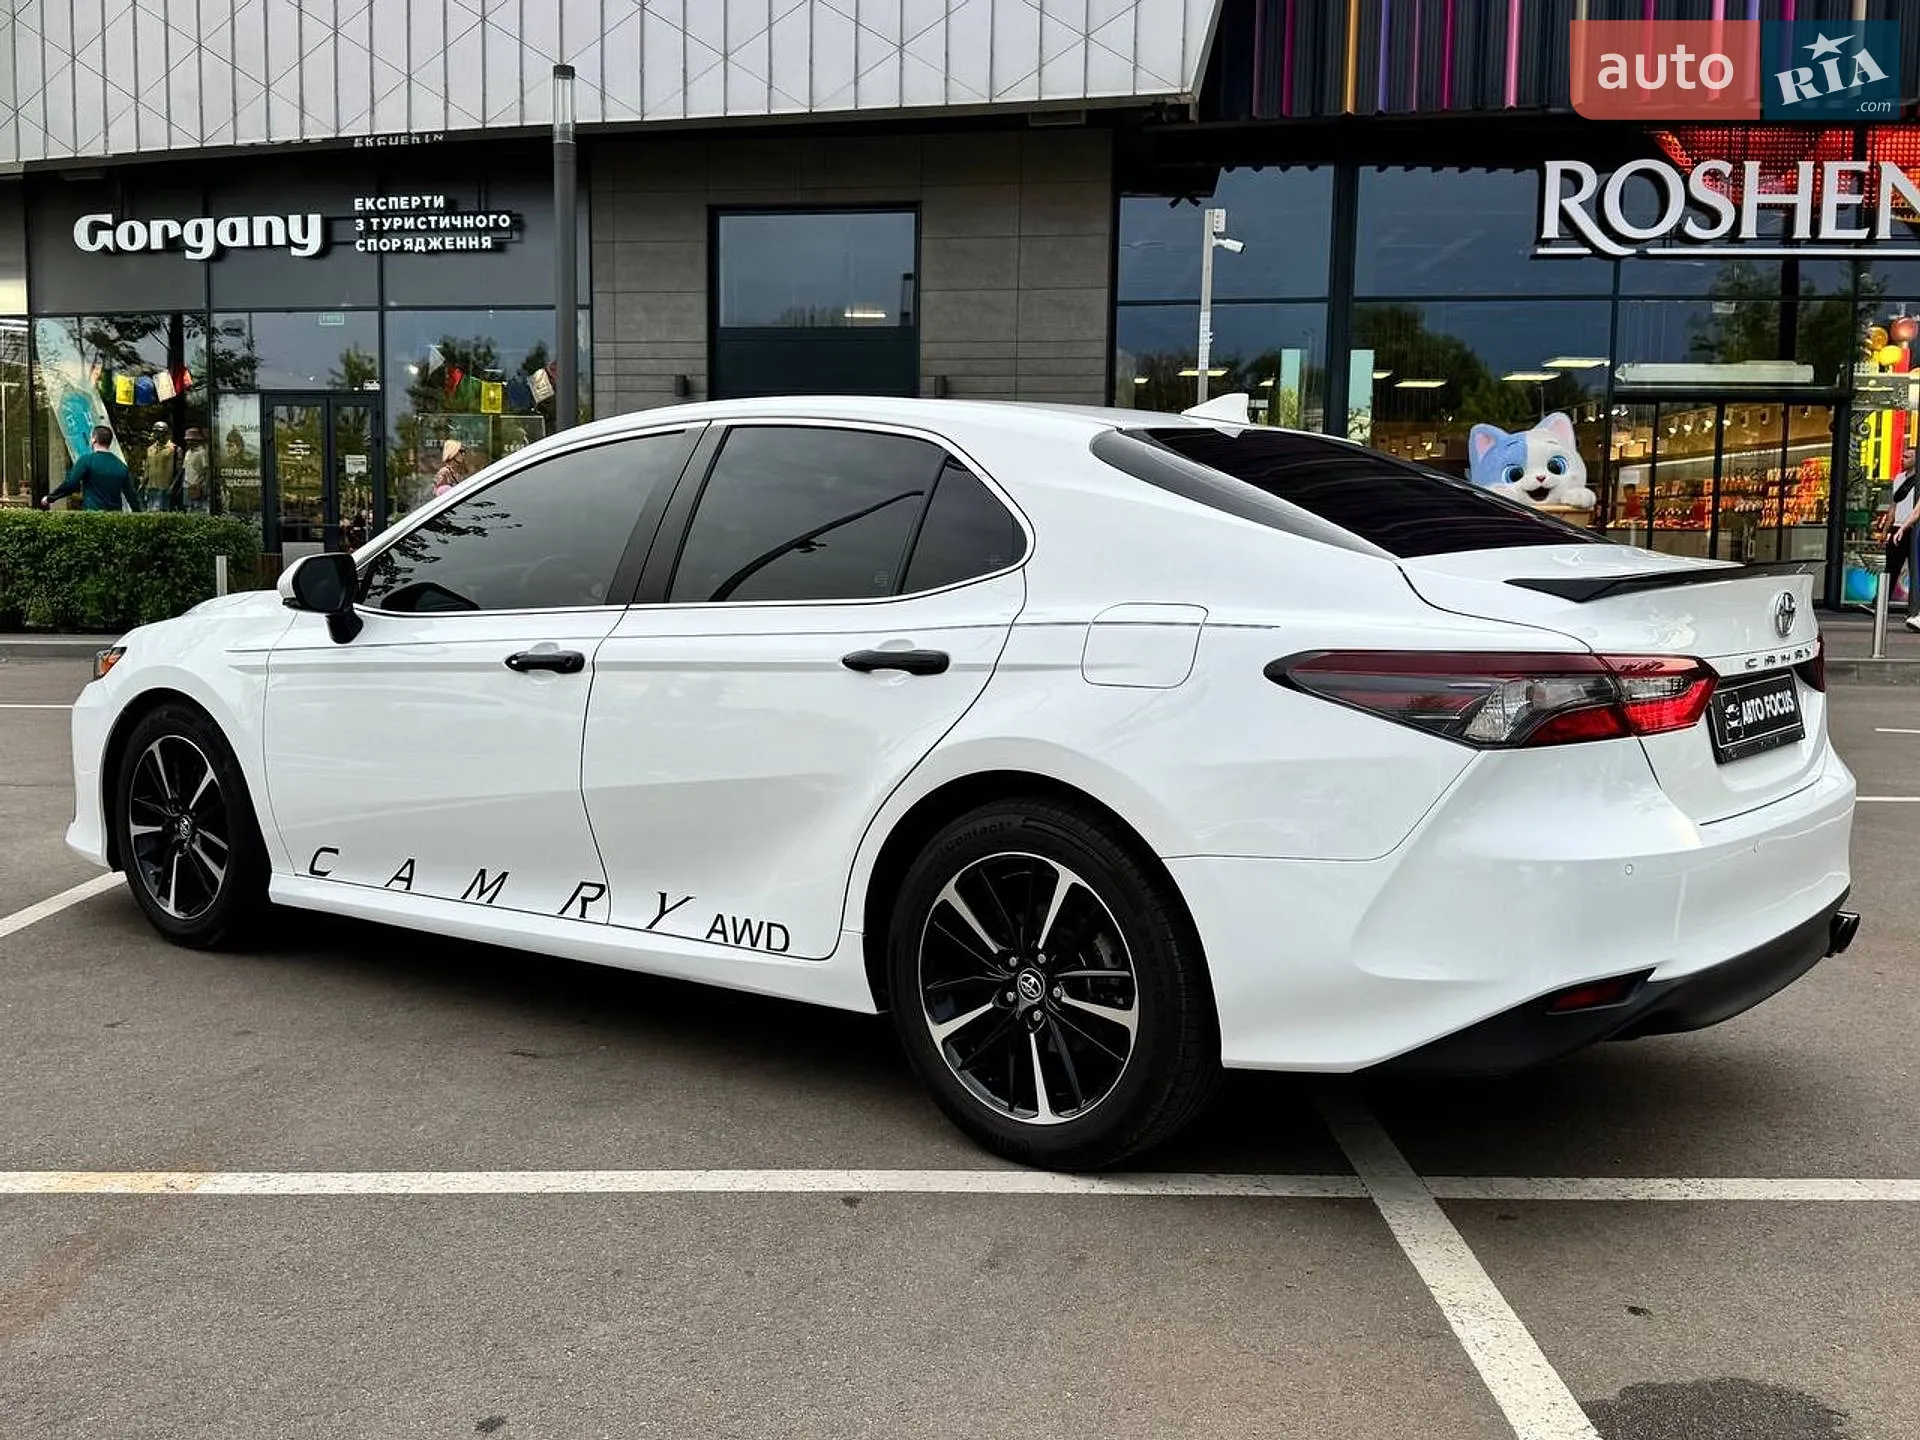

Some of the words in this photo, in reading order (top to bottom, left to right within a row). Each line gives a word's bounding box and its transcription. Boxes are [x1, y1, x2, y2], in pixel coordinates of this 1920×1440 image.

[354, 195, 444, 211] ЕКСПЕРТИ
[1541, 159, 1920, 255] ROSHEN
[73, 213, 322, 260] Gorgany
[371, 214, 510, 231] ТУРИСТИЧНОГО
[355, 236, 492, 252] СПОРЯДЖЕННЯ
[1763, 689, 1795, 718] FOCUS
[706, 913, 790, 953] AWD
